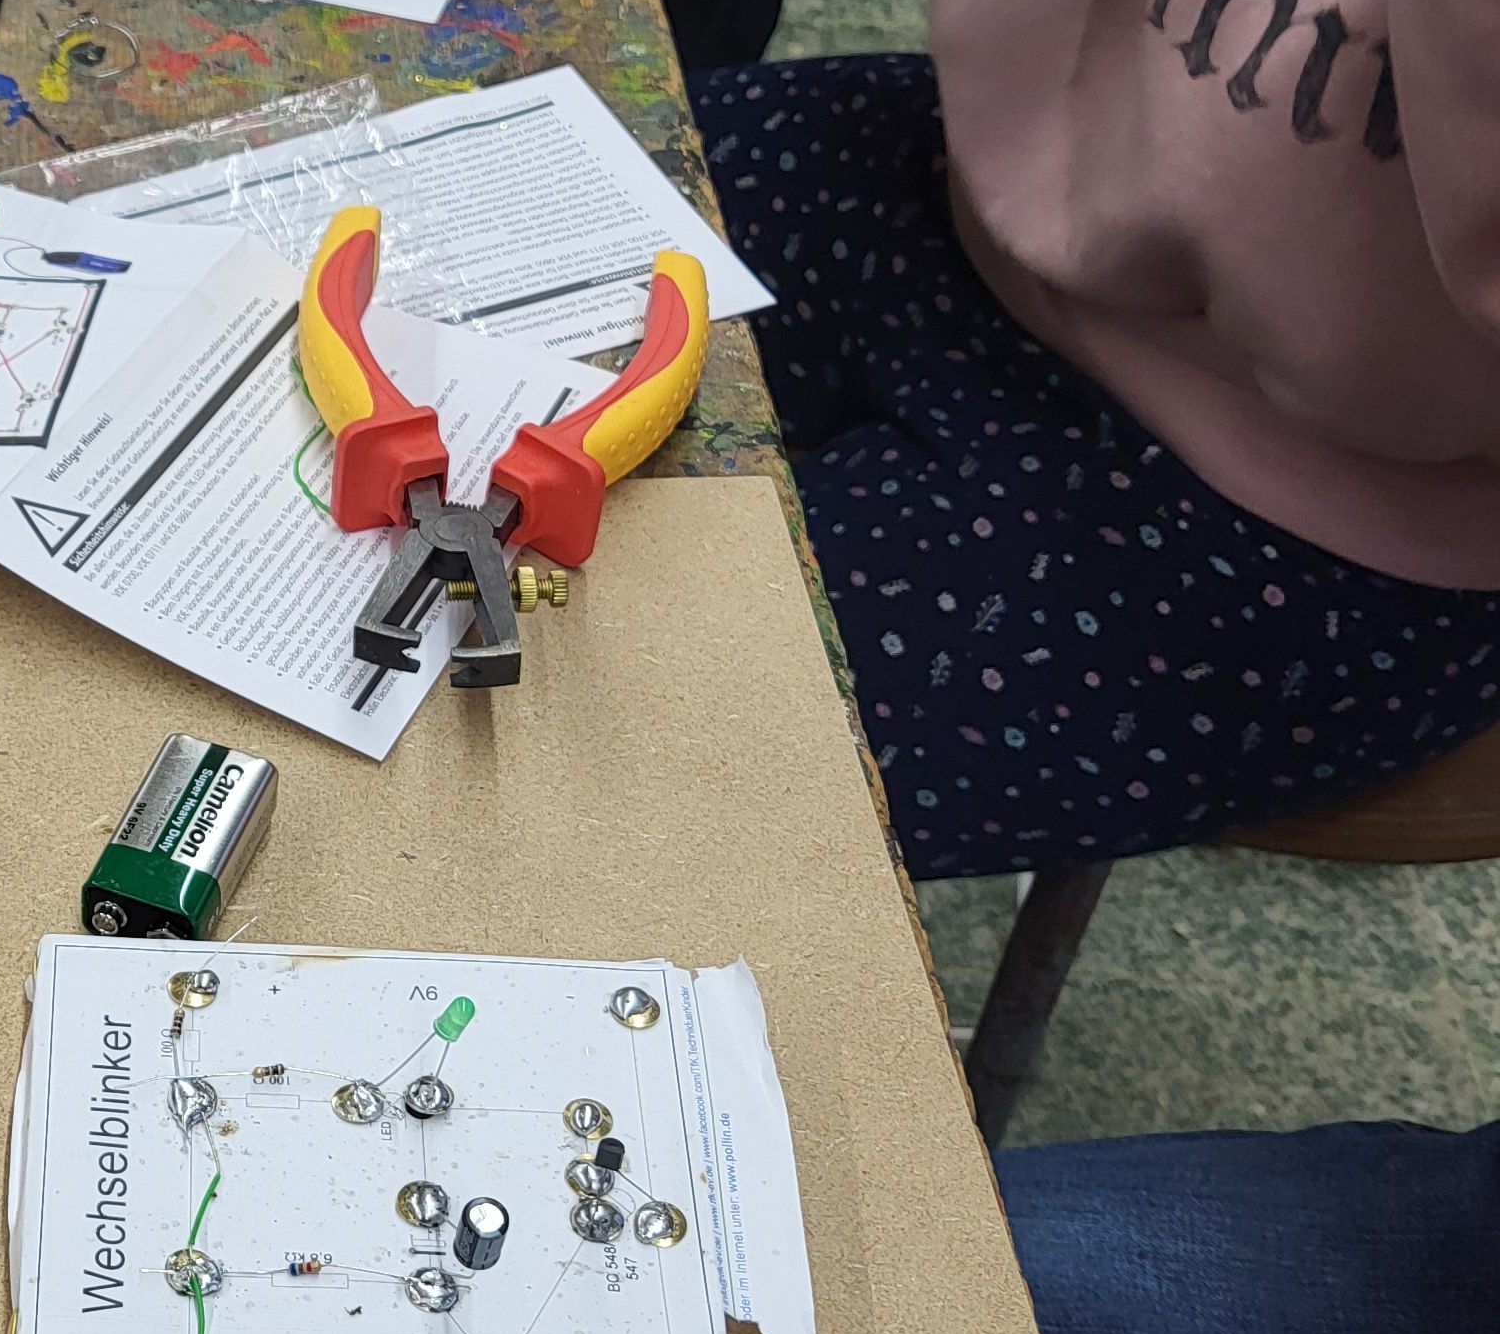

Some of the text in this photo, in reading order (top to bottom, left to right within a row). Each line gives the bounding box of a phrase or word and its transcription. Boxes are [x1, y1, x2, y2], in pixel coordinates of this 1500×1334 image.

[45, 412, 113, 488] Wichtiger Hinweis!
[67, 499, 132, 569] Sicherheitshinweise:
[117, 800, 147, 843] 9V 6F22
[157, 765, 213, 853] Super Heavy Duty
[179, 760, 245, 860] Camelion
[408, 982, 439, 1001] 9V
[381, 1121, 393, 1141] LED
[719, 1112, 739, 1192] www.pollin.de
[81, 1013, 133, 1315] Wechselblinker
[624, 1257, 639, 1281] 547
[731, 1230, 747, 1274] Internet
[736, 1277, 749, 1291] im
